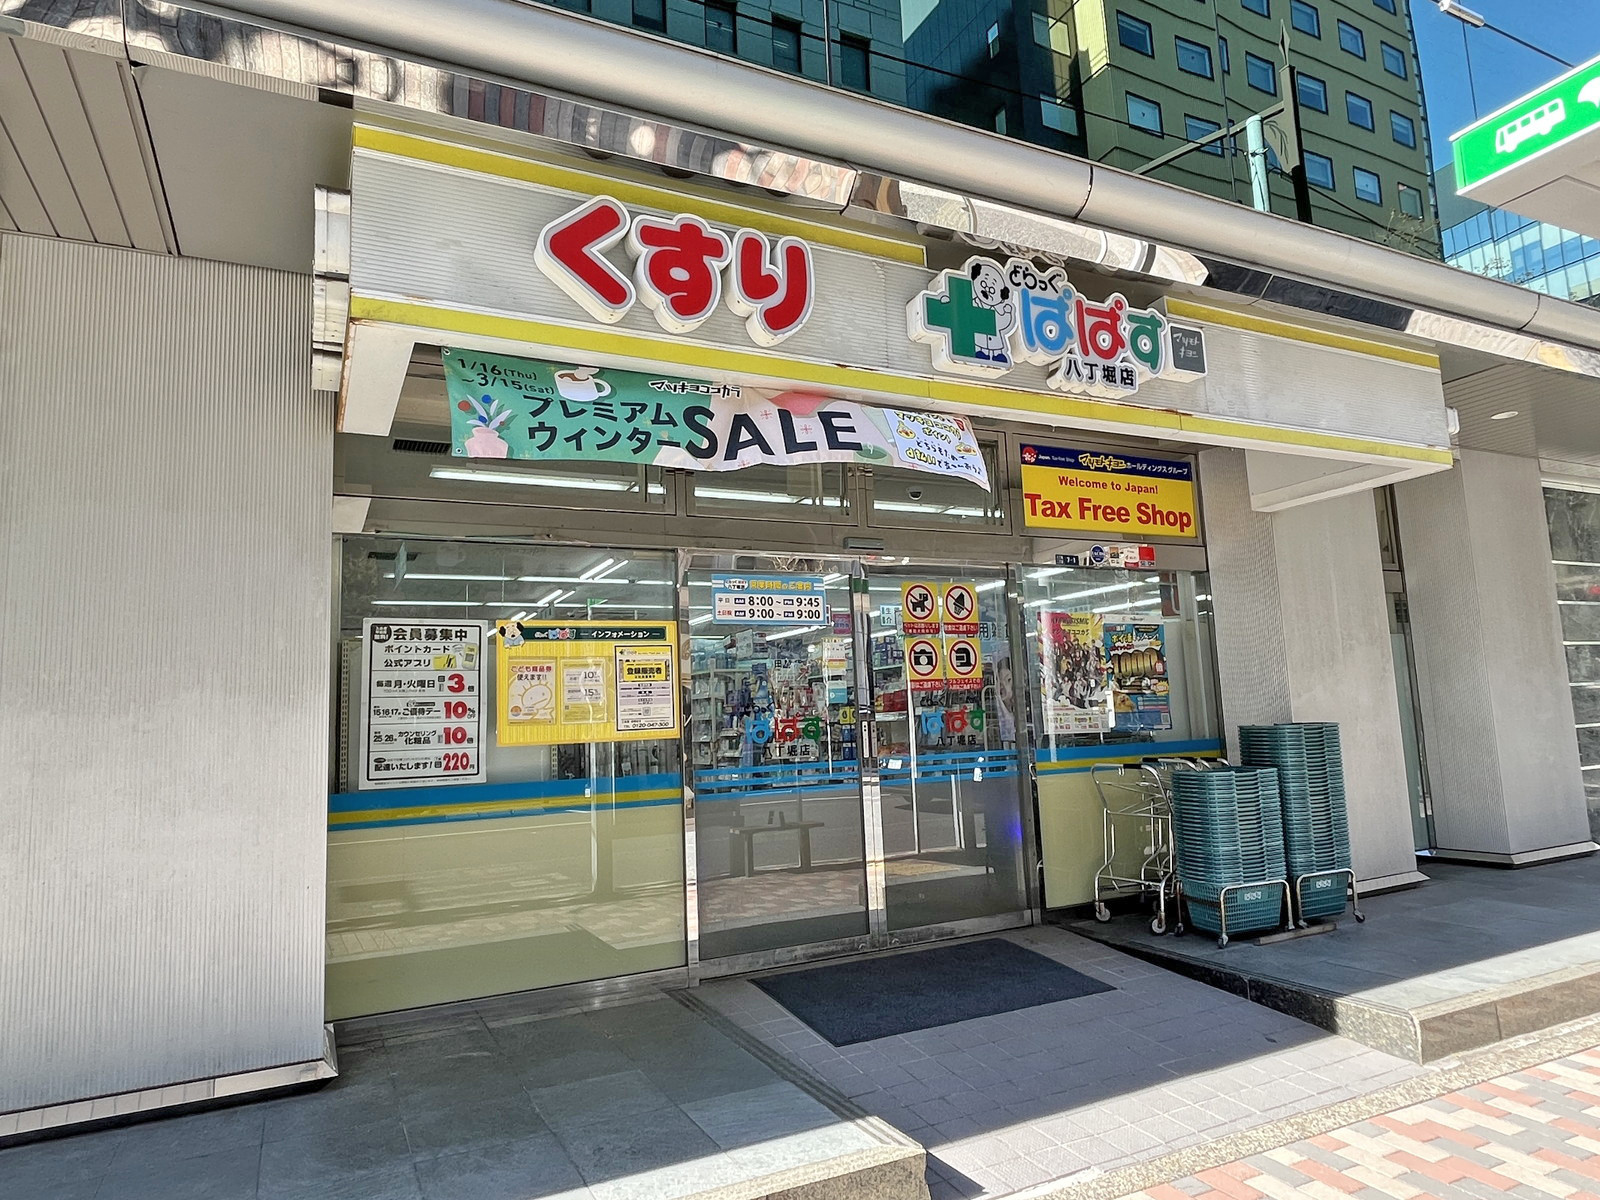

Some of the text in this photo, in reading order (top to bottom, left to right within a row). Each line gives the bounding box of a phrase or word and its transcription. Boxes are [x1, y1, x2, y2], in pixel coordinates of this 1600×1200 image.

[548, 203, 808, 332] くすり
[1009, 264, 1062, 294] どらっぐ
[1020, 287, 1166, 372] ぱぱす
[457, 358, 537, 381] 1/16(Thu)
[1066, 358, 1136, 388] 八丁堀店
[648, 379, 741, 399] マツキヨココカラ
[522, 394, 679, 428] プレミアム
[527, 420, 681, 455] ウィンター
[681, 404, 863, 461] SALE
[1058, 475, 1159, 495] Welcome to Japan!
[1024, 493, 1192, 533] Tax Free Shop
[748, 595, 774, 607] 8:00
[796, 596, 820, 607] 9:45
[748, 608, 775, 619] 9:00
[797, 609, 821, 619] 9:00
[393, 627, 468, 642] 会員募集中
[591, 630, 650, 639] インフォメーション
[384, 644, 450, 654] ポイントカード
[447, 673, 466, 693] 3
[443, 701, 468, 719] 10
[397, 729, 437, 739] カウンセリング
[404, 737, 431, 746] 化粧品
[443, 727, 468, 745] 10
[442, 752, 470, 772] 220
